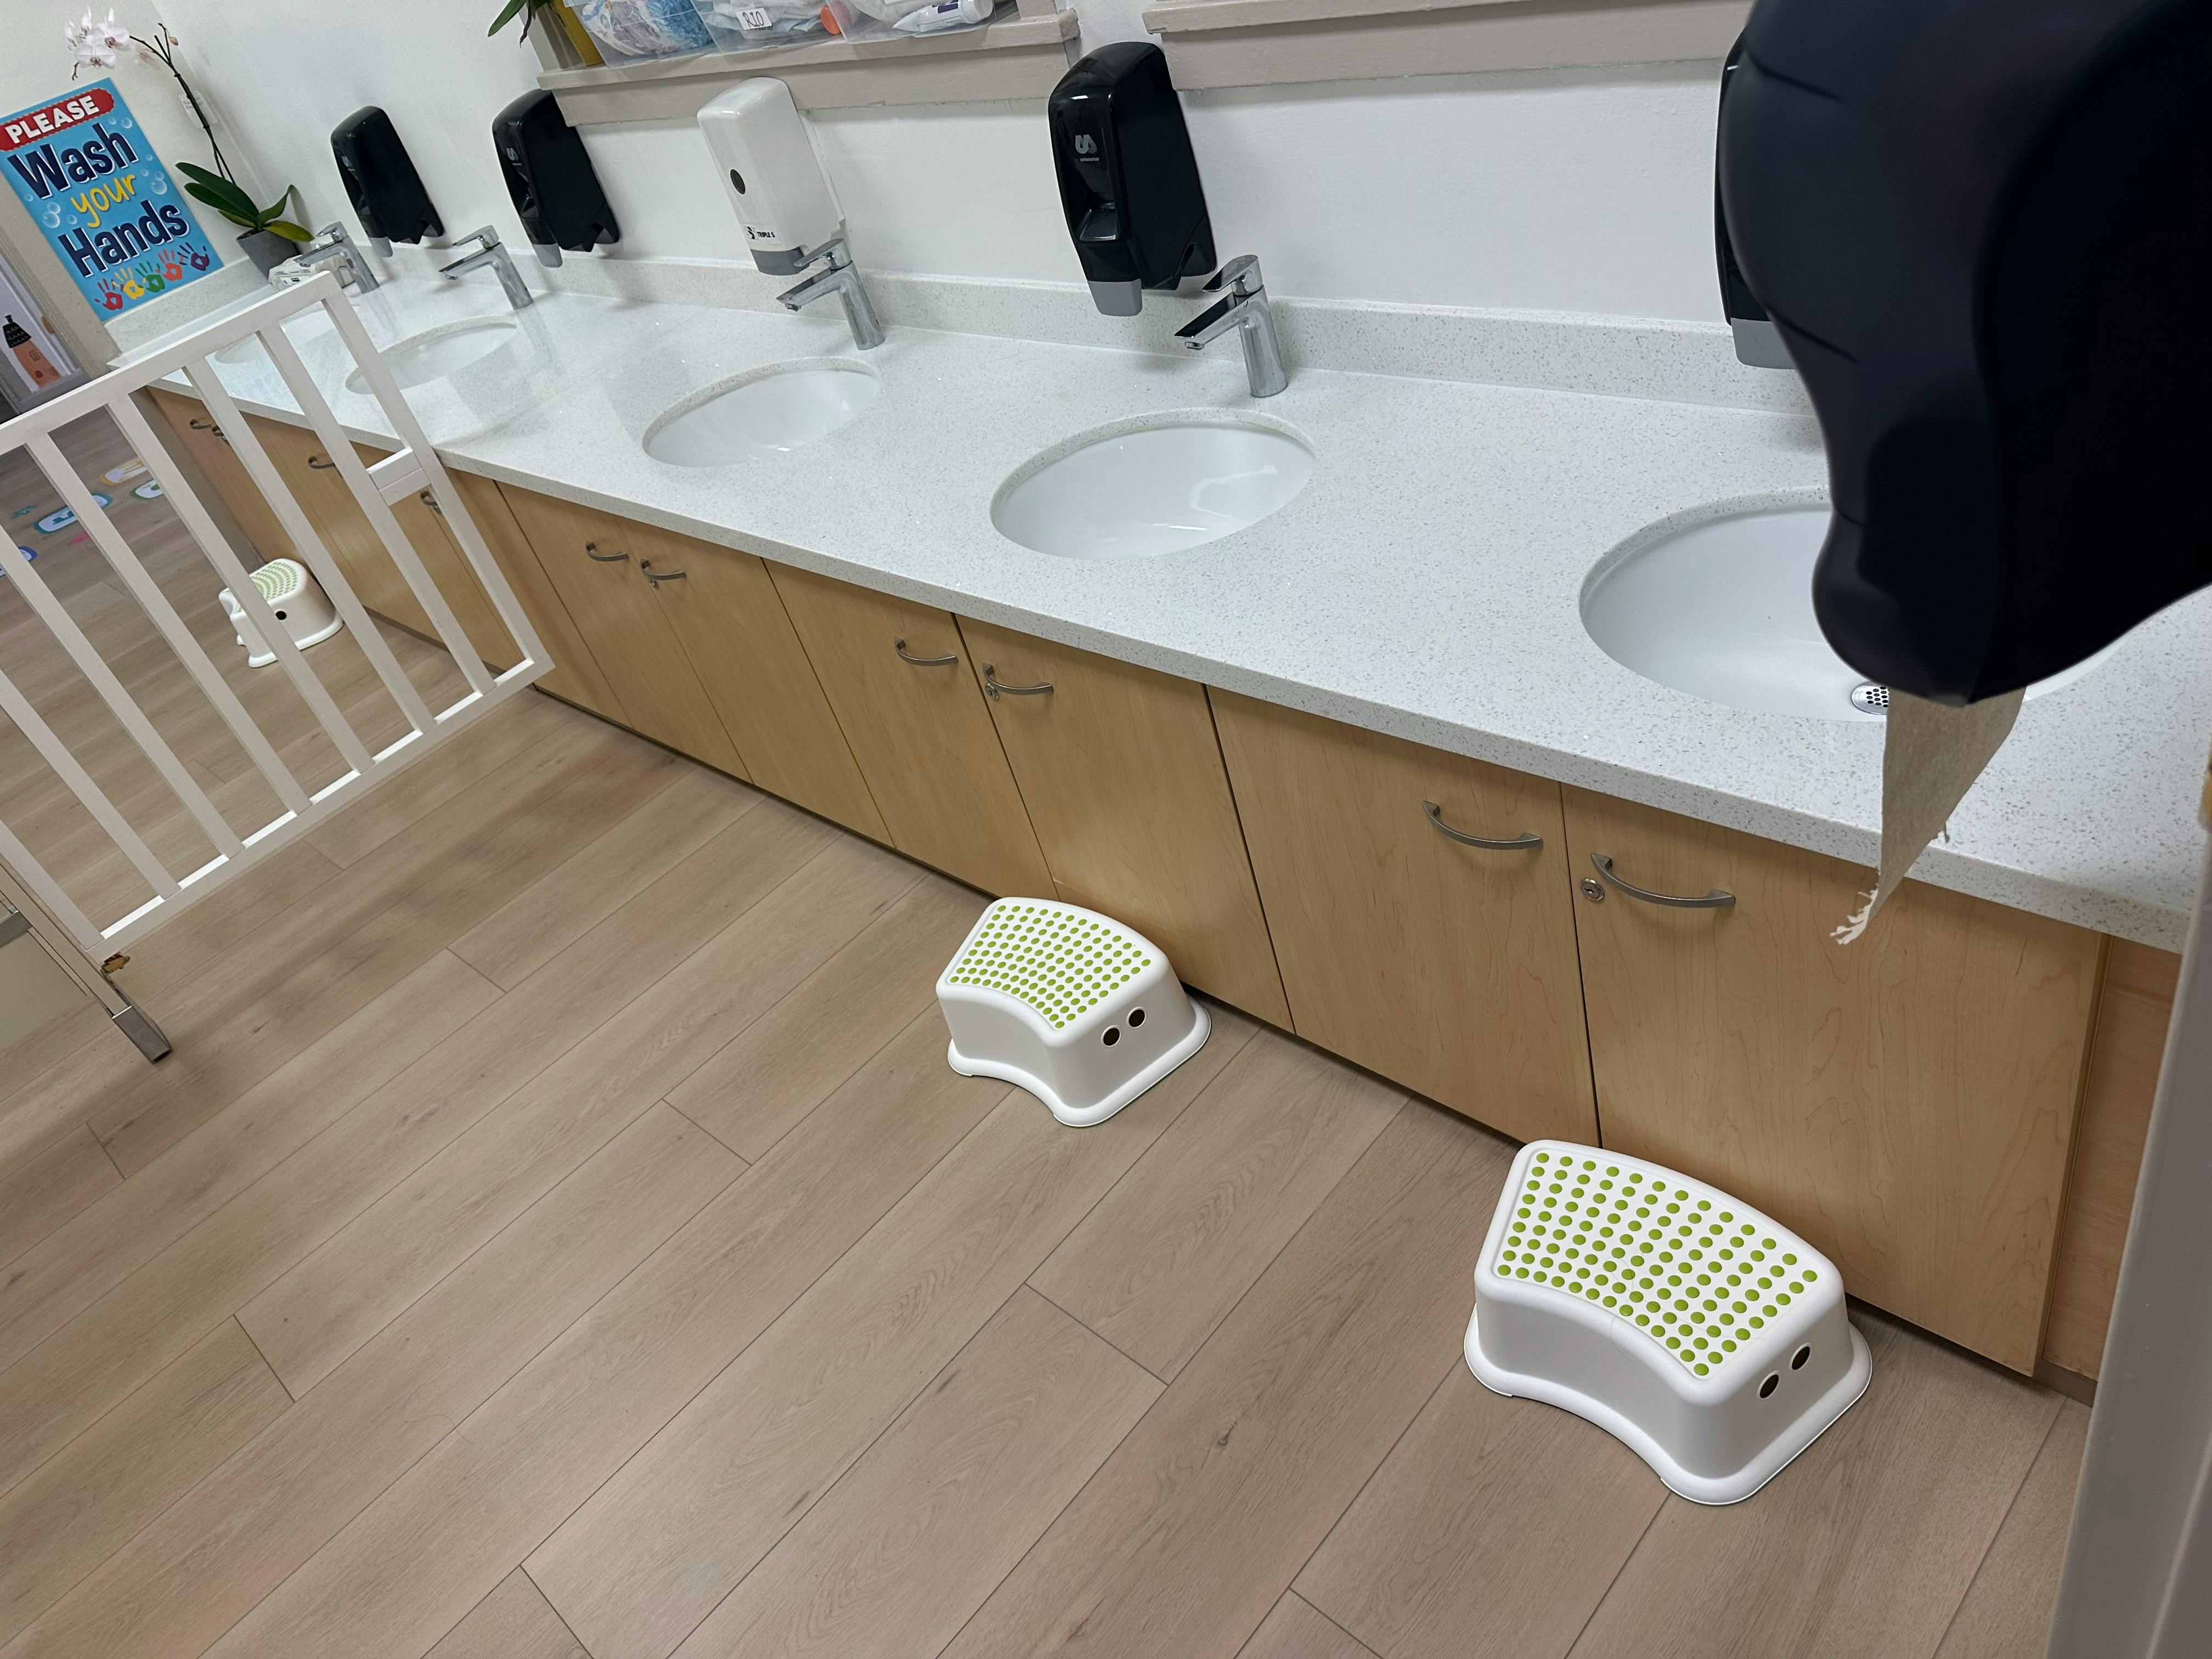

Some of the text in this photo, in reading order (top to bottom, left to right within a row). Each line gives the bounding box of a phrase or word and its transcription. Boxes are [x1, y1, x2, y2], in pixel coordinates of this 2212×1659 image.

[5, 95, 99, 144] PLEASE
[7, 123, 139, 199] Wash
[70, 174, 136, 228] your
[58, 200, 190, 278] Hands
